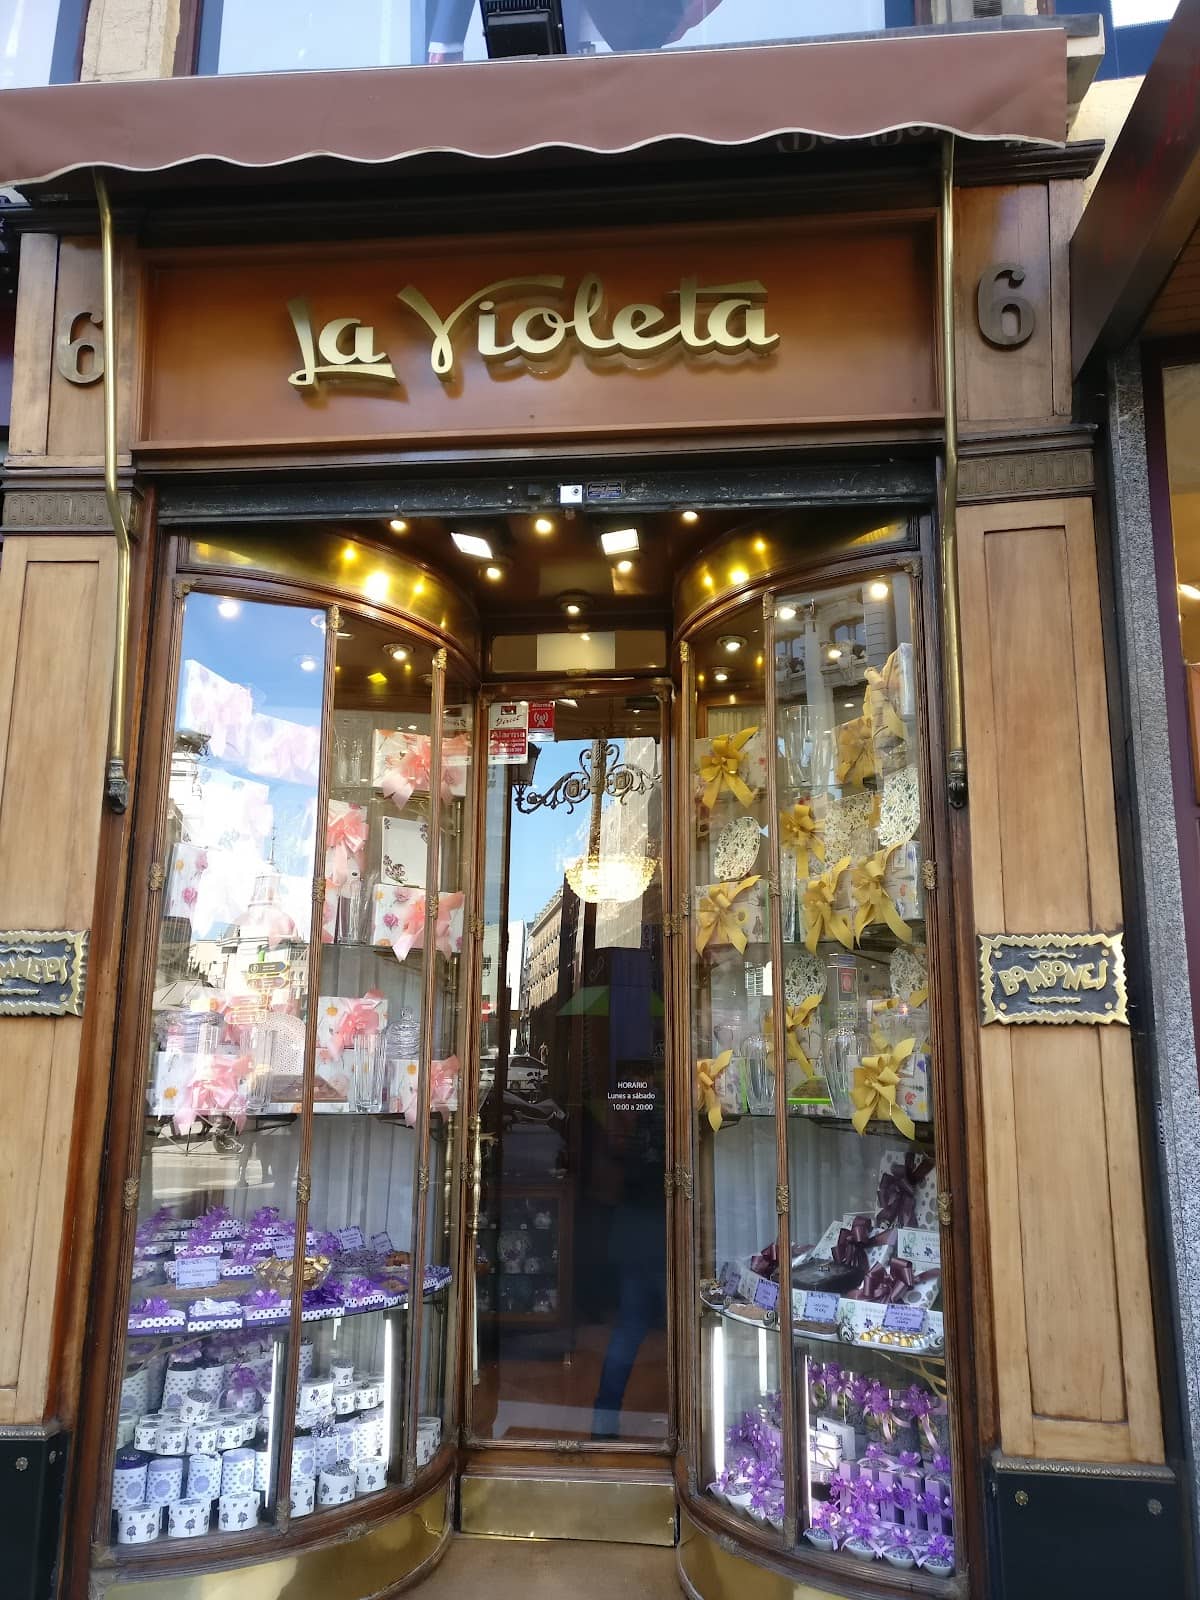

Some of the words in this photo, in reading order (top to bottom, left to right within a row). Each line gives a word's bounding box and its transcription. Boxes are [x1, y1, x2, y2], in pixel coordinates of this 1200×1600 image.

[977, 263, 1037, 350] 6
[287, 296, 397, 386] La
[397, 273, 780, 375] Violeta
[56, 309, 105, 386] 6
[490, 731, 526, 739] Alarma
[0, 953, 68, 985] AMELOS
[998, 959, 1109, 996] BOMBONES
[617, 1081, 648, 1089] HORARIO
[612, 1103, 630, 1111] 10:00
[636, 1103, 653, 1111] 20:00
